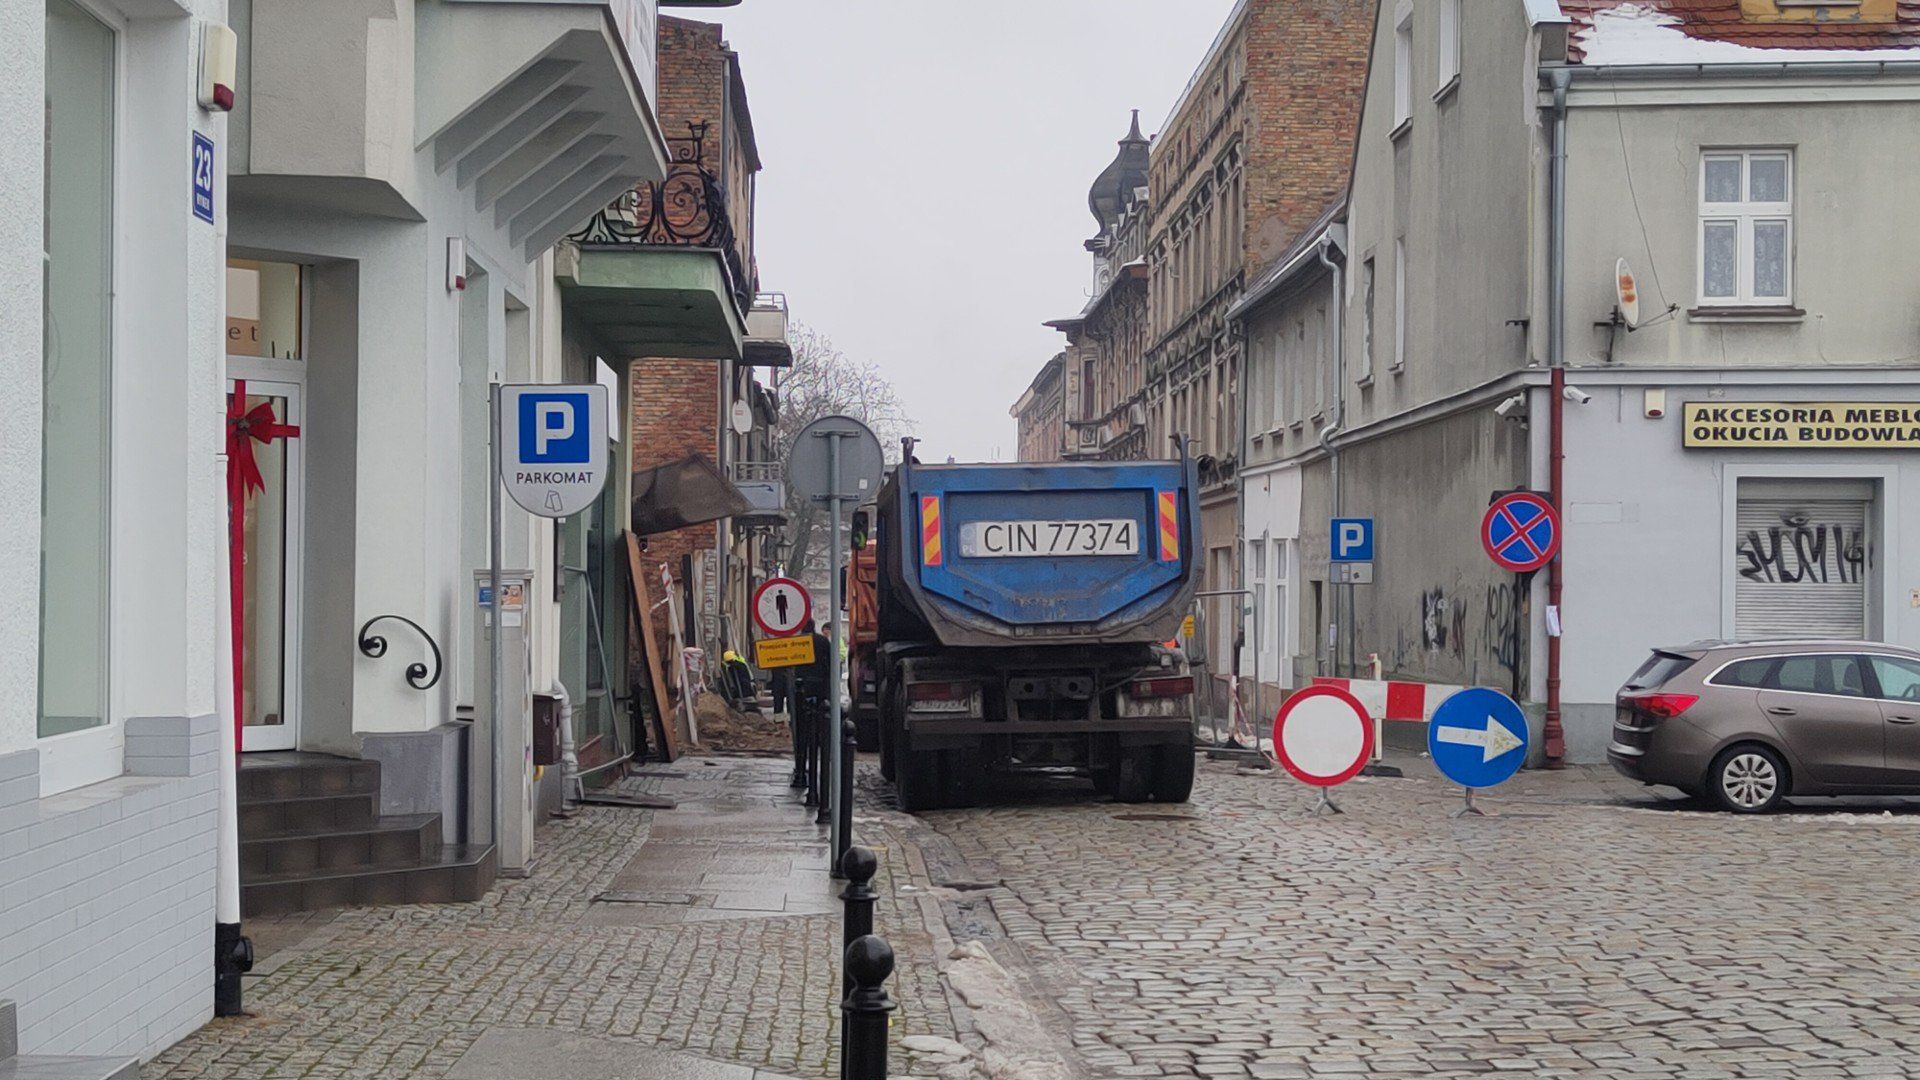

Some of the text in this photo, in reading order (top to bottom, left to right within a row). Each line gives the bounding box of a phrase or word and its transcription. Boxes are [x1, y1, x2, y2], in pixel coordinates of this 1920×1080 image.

[196, 145, 211, 192] 23
[536, 401, 575, 455] P
[1693, 408, 1835, 423] AKCESORIA
[1692, 426, 1789, 441] OKUCIA
[516, 472, 593, 484] PARKOMAT
[984, 523, 1130, 552] CIN 77374
[1340, 523, 1364, 557] P
